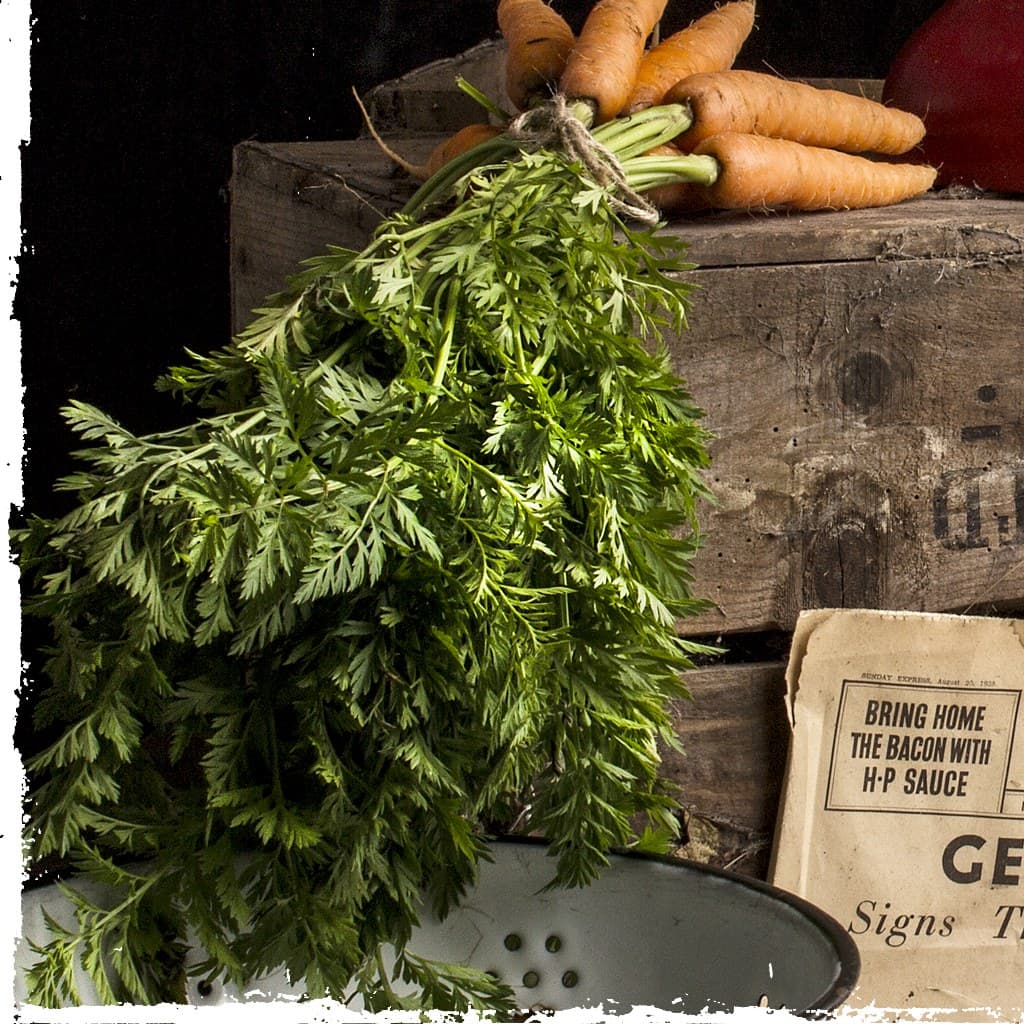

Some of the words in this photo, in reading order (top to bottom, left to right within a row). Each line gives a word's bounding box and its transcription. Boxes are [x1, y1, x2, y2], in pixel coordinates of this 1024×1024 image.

[865, 700, 928, 729] BRING
[932, 704, 986, 731] HOME
[851, 732, 883, 759] THE
[886, 734, 947, 762] BACON
[950, 737, 992, 765] WITH
[904, 768, 969, 797] SAUCE
[848, 900, 956, 948] Signs
